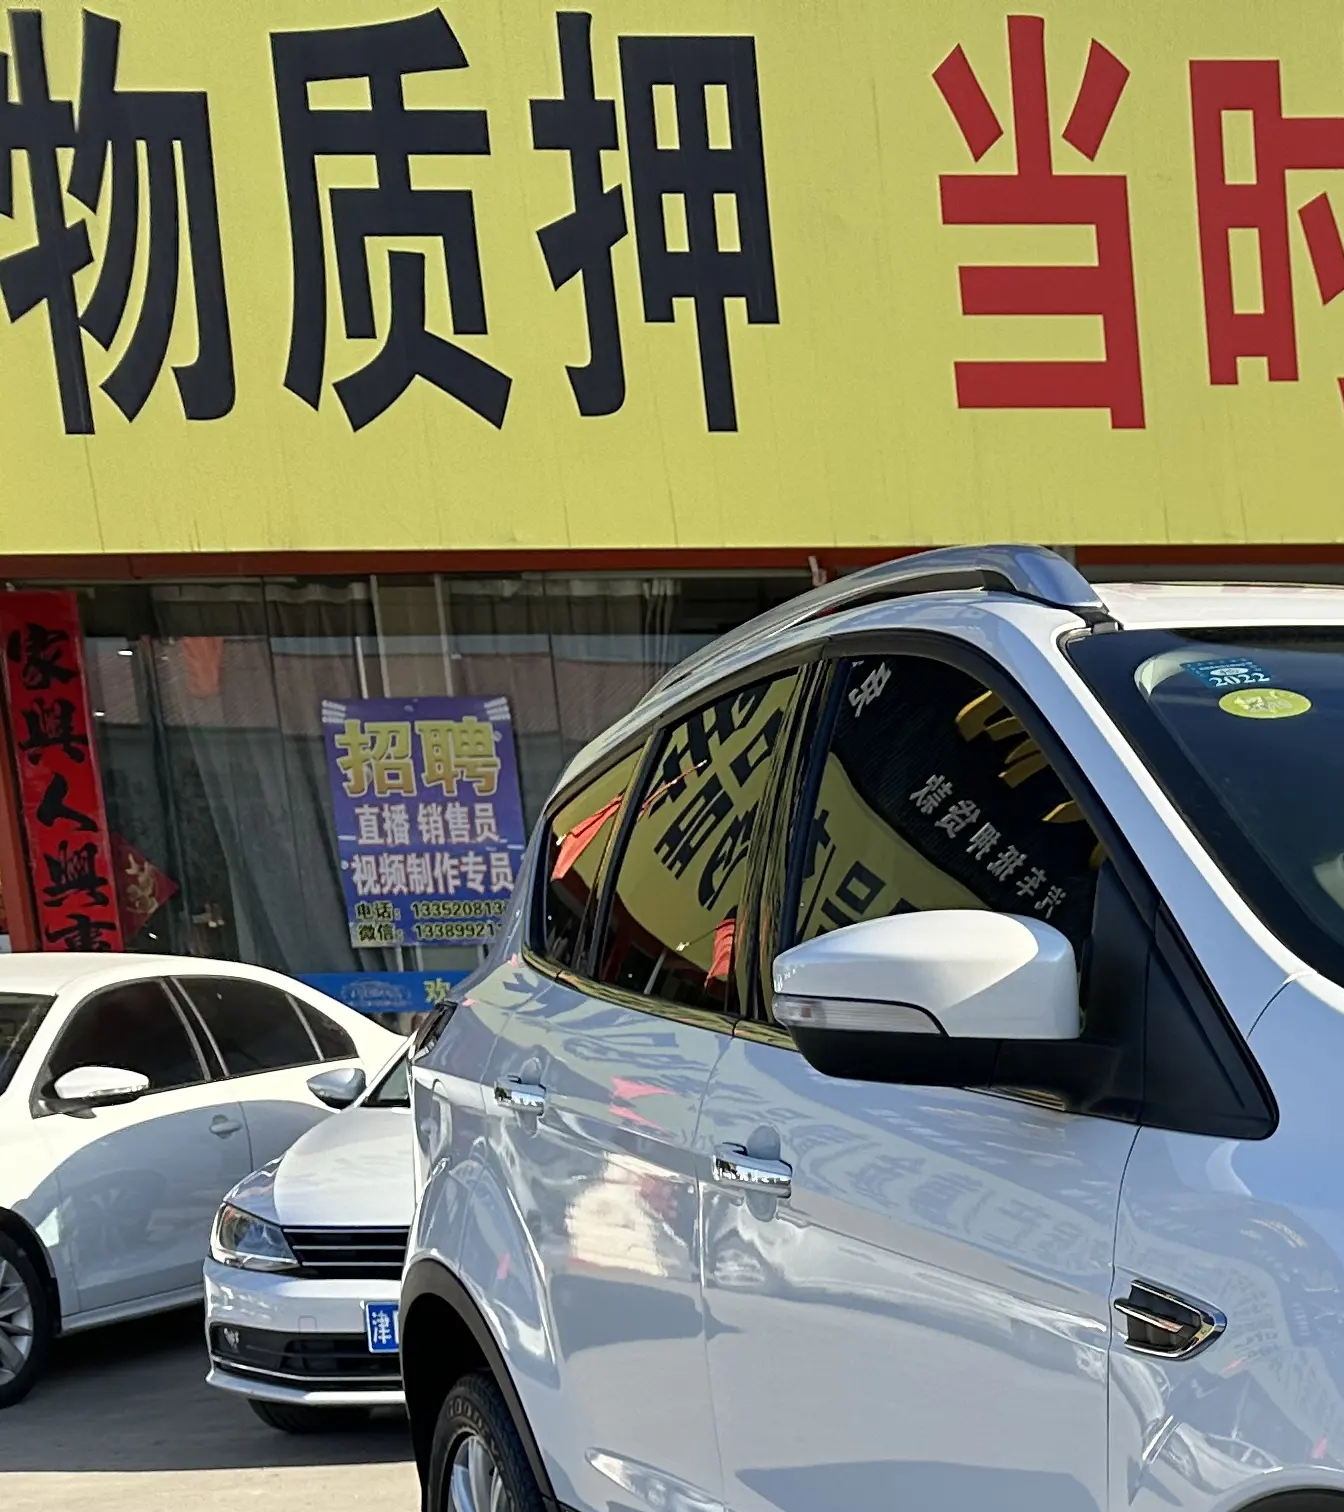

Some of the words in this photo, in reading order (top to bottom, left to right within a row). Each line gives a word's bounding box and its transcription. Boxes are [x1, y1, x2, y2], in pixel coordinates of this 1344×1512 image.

[0, 8, 781, 436] 物质押
[1208, 672, 1271, 688] 2022
[334, 716, 502, 798] 招聘
[354, 803, 410, 846] 直播
[417, 802, 500, 845] 销售员
[352, 851, 515, 896] 视频制作专员
[413, 922, 502, 940] 13389921
[371, 1309, 399, 1345] 津
